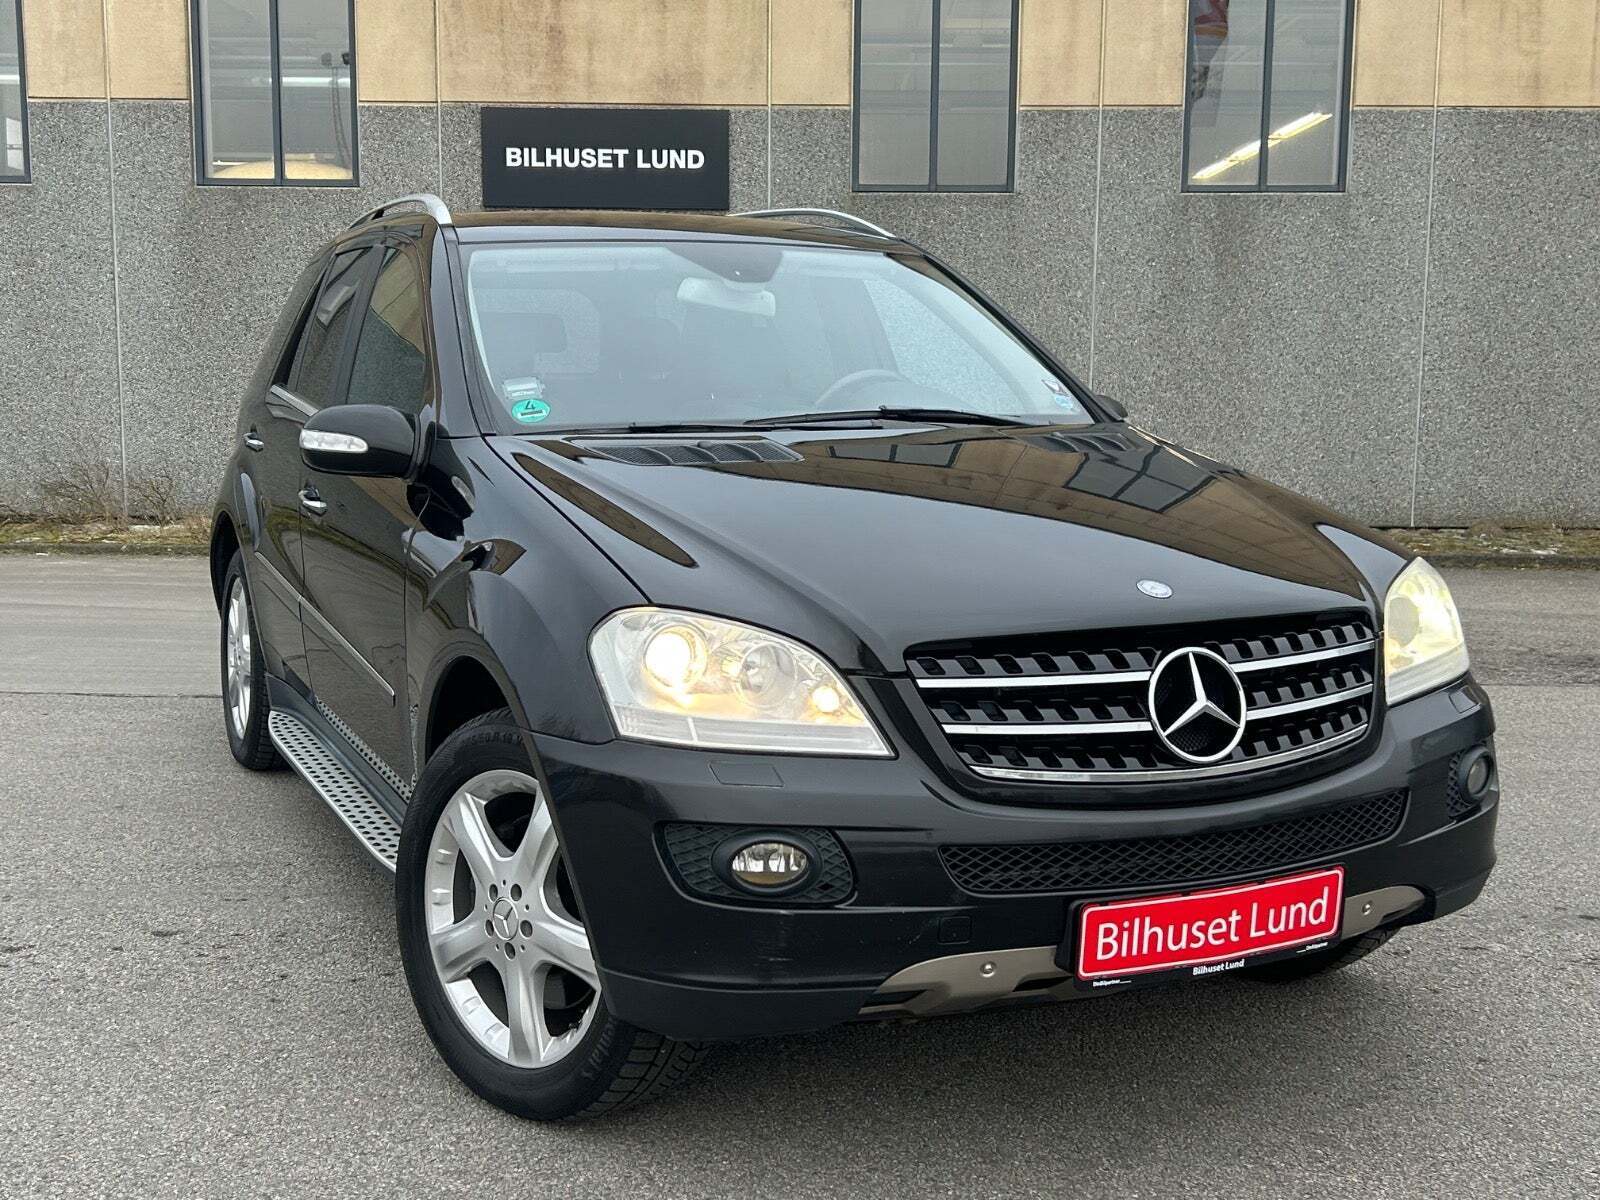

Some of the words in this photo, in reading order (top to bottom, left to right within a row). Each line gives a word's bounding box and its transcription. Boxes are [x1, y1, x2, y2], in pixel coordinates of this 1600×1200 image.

[505, 147, 629, 169] BILHUSET
[636, 149, 705, 169] LUND
[1096, 908, 1242, 961] Bilhuset
[1249, 885, 1329, 938] Lund
[1192, 962, 1225, 976] Bilhuset
[1225, 958, 1245, 970] Lund
